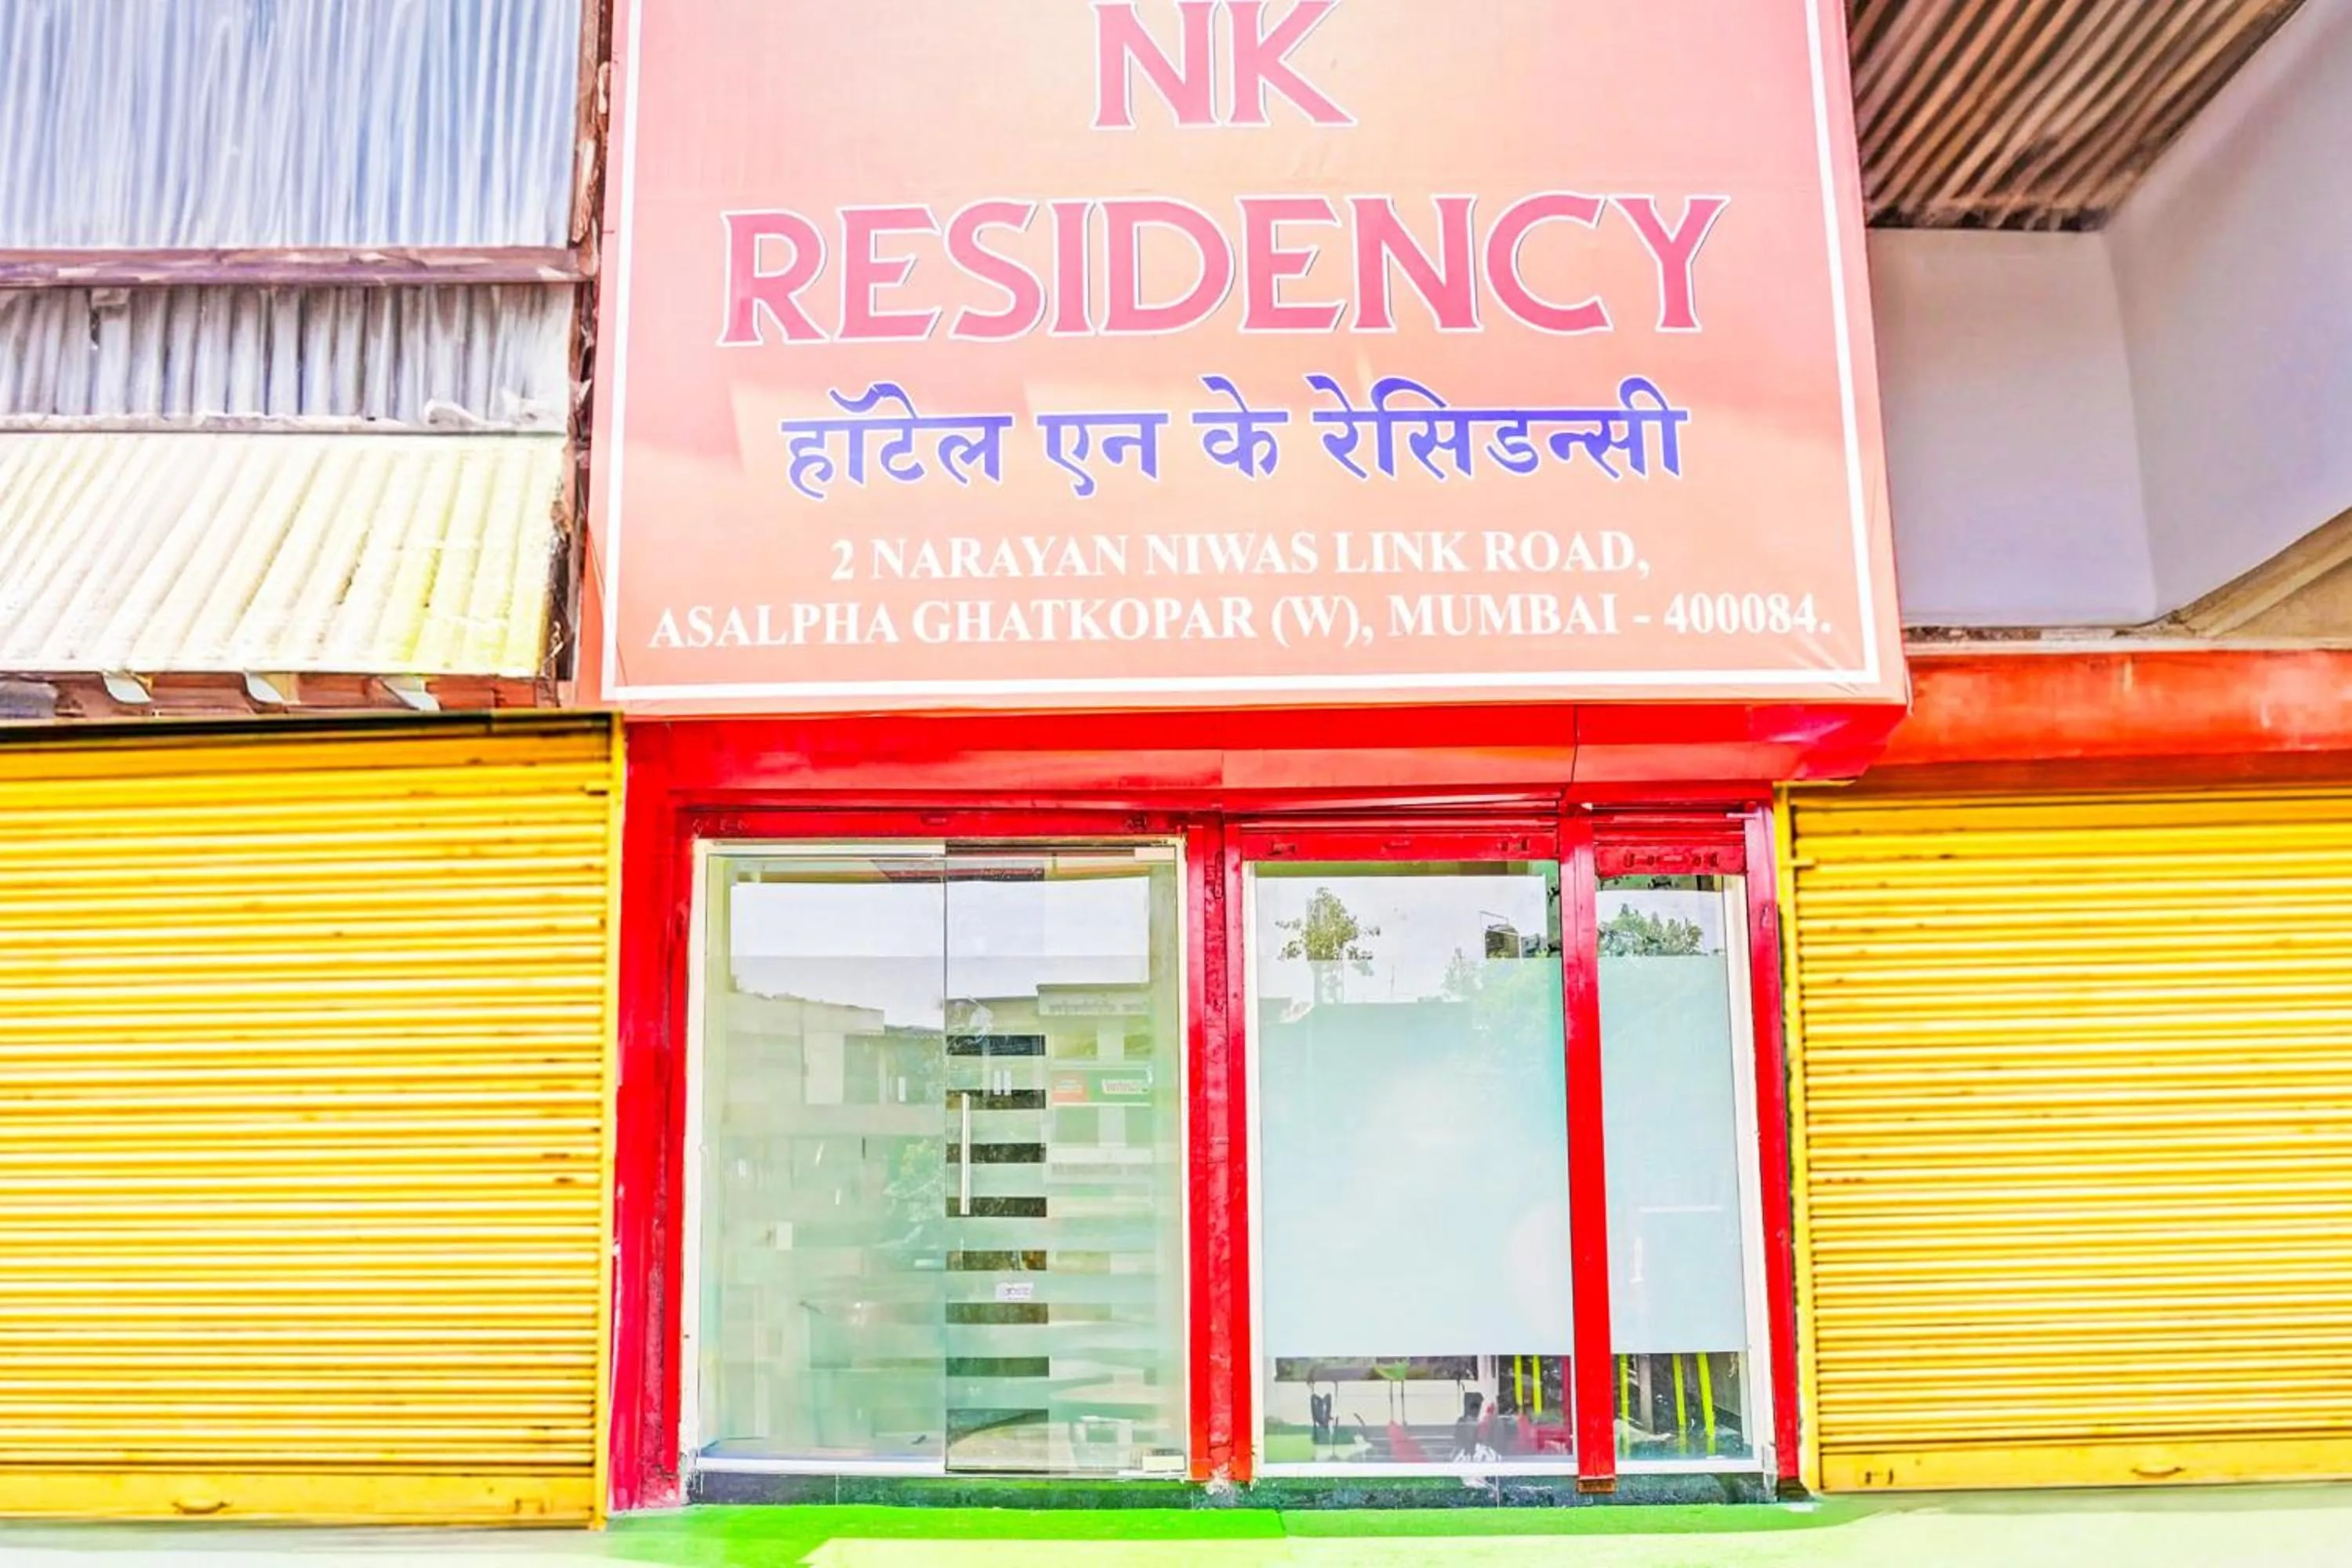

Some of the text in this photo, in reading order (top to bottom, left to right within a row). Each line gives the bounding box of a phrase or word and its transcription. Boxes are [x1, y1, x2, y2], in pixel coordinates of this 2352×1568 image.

[1089, 0, 1358, 129] NK
[718, 192, 1731, 347] RESIDENCY
[781, 373, 1689, 500] हॉटेल एन के रेसिडन्सी
[830, 530, 1651, 581] 2 NARAYAN NIWAS LINK ROAD,
[648, 602, 900, 648] ASALPHA
[912, 597, 1258, 644] GHATKOPAR
[1270, 596, 1375, 648] (W),
[1388, 593, 1621, 637] MUMBAI
[1663, 592, 1832, 636] 400084.
